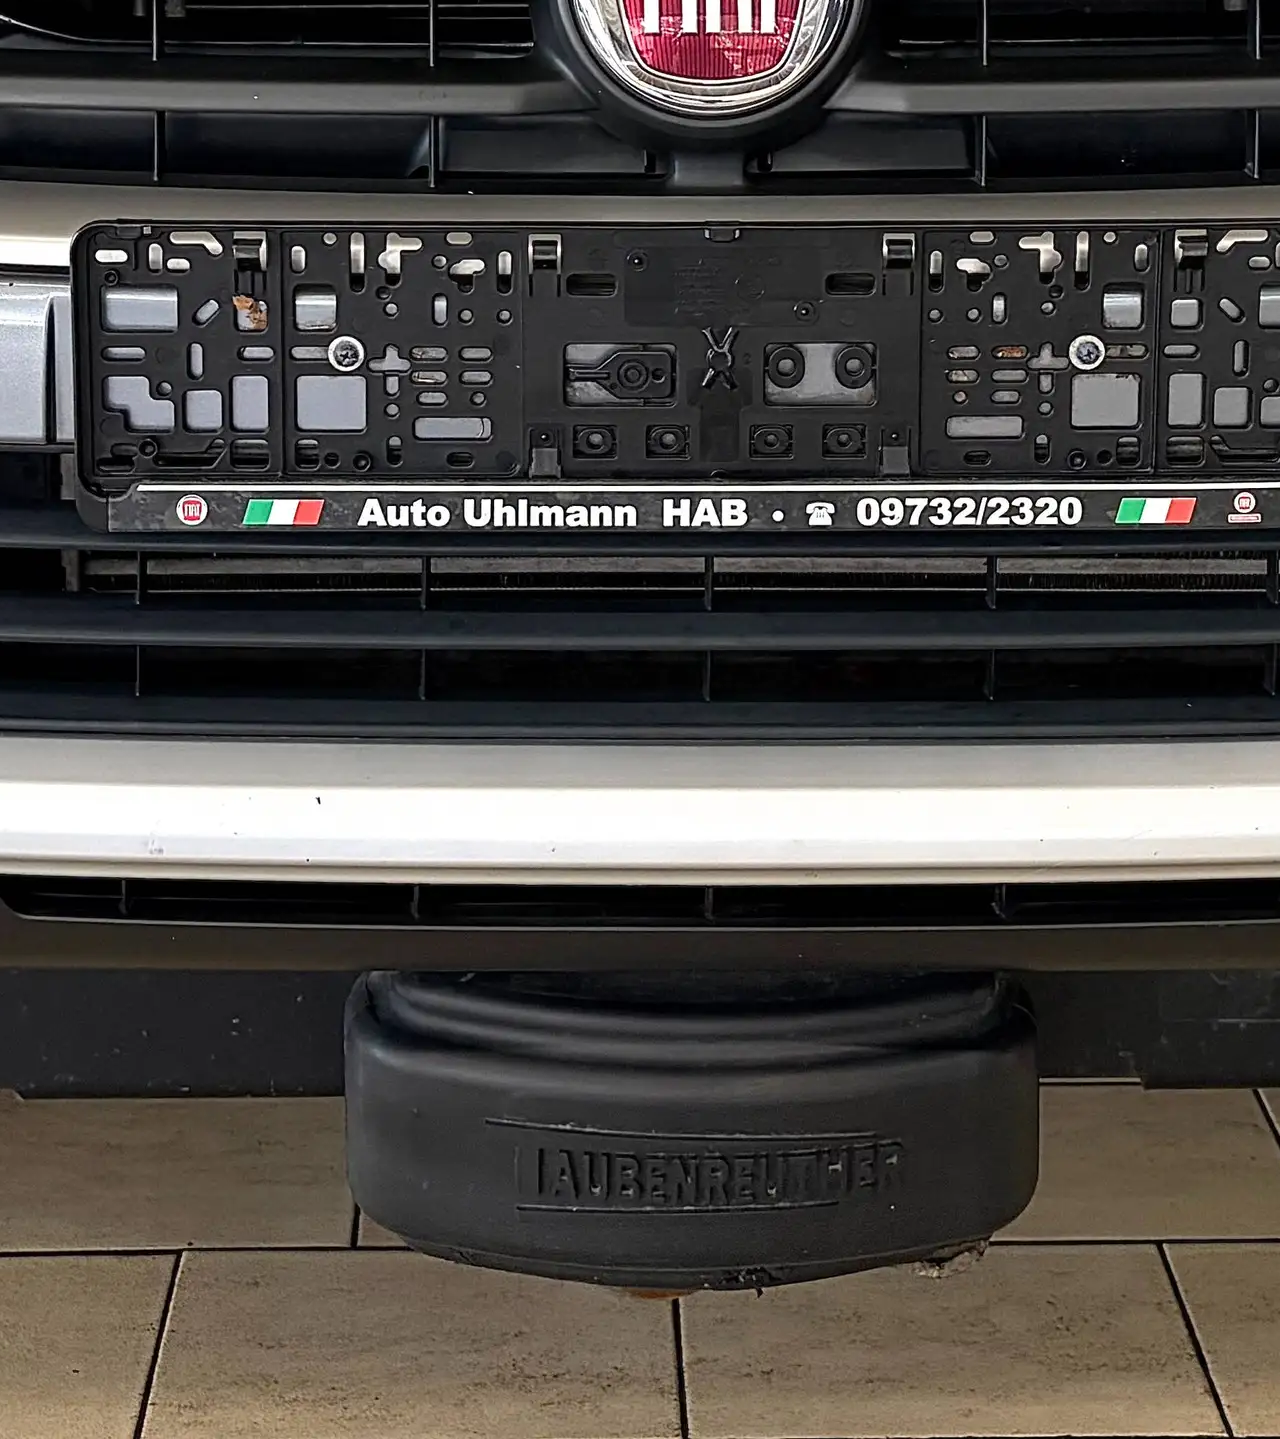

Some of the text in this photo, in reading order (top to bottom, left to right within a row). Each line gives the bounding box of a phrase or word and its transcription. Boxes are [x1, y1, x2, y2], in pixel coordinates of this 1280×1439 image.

[356, 496, 1083, 527] Auto Uhlmann HAB 09732/2320
